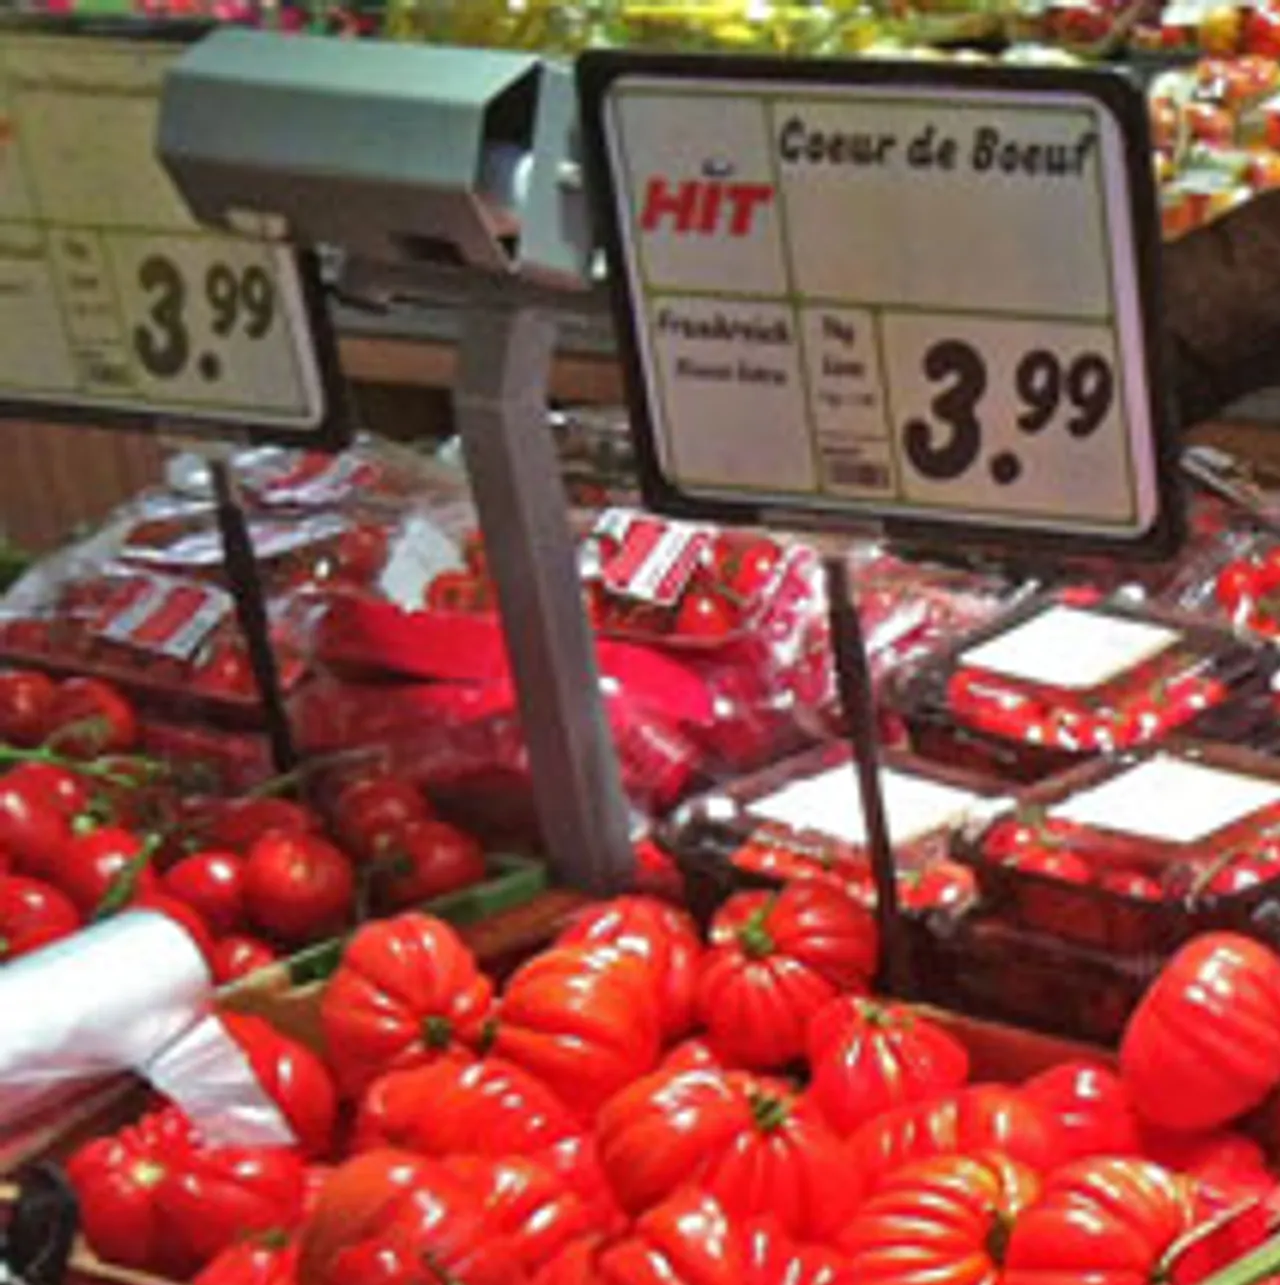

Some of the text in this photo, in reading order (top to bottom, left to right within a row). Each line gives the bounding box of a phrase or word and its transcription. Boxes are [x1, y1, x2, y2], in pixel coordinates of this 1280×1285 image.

[779, 112, 1097, 178] Coeur de Boeuf
[640, 174, 776, 237] HIT
[133, 252, 275, 382] 3.99
[903, 338, 1114, 485] 3.99
